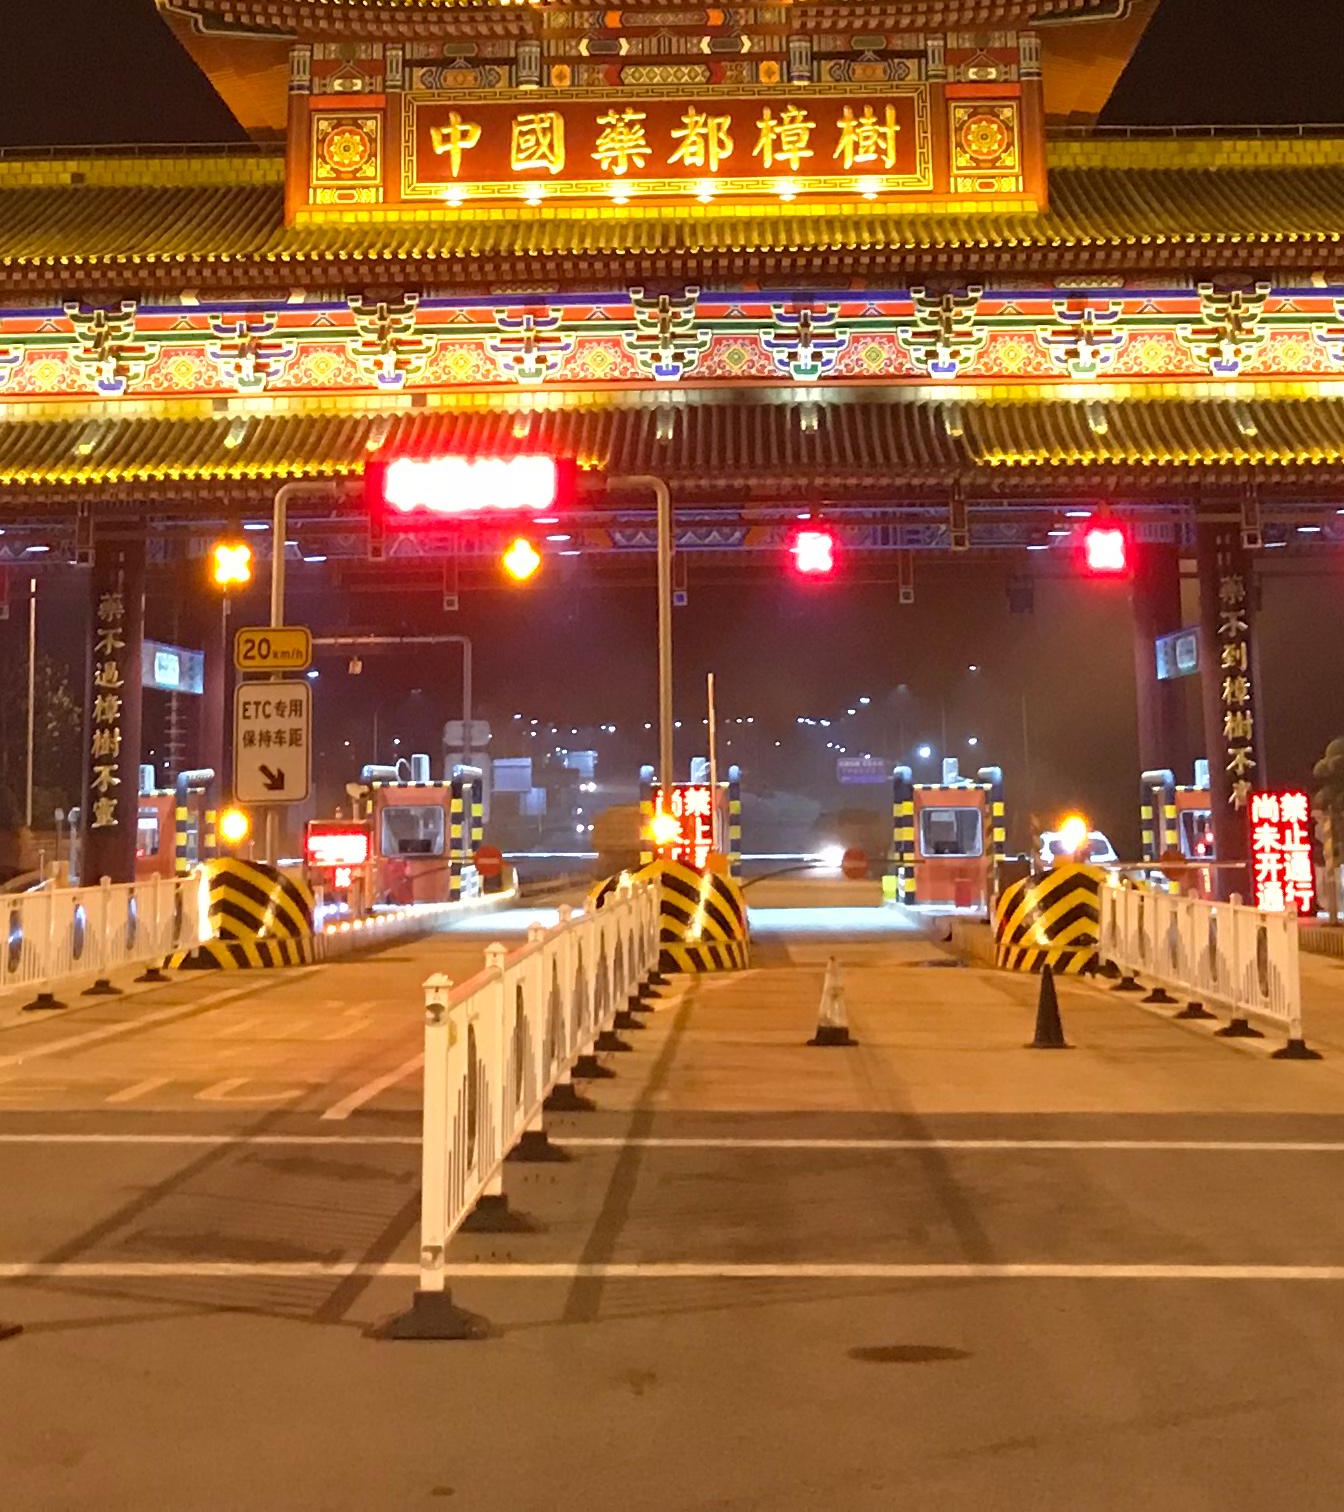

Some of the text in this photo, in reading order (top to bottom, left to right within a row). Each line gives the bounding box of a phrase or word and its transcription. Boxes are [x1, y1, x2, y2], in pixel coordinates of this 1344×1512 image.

[429, 104, 901, 178] 中國藥都樟樹
[242, 728, 303, 748] 保持车距
[1252, 792, 1286, 912] 尚未开通
[1280, 792, 1314, 912] 禁止通行
